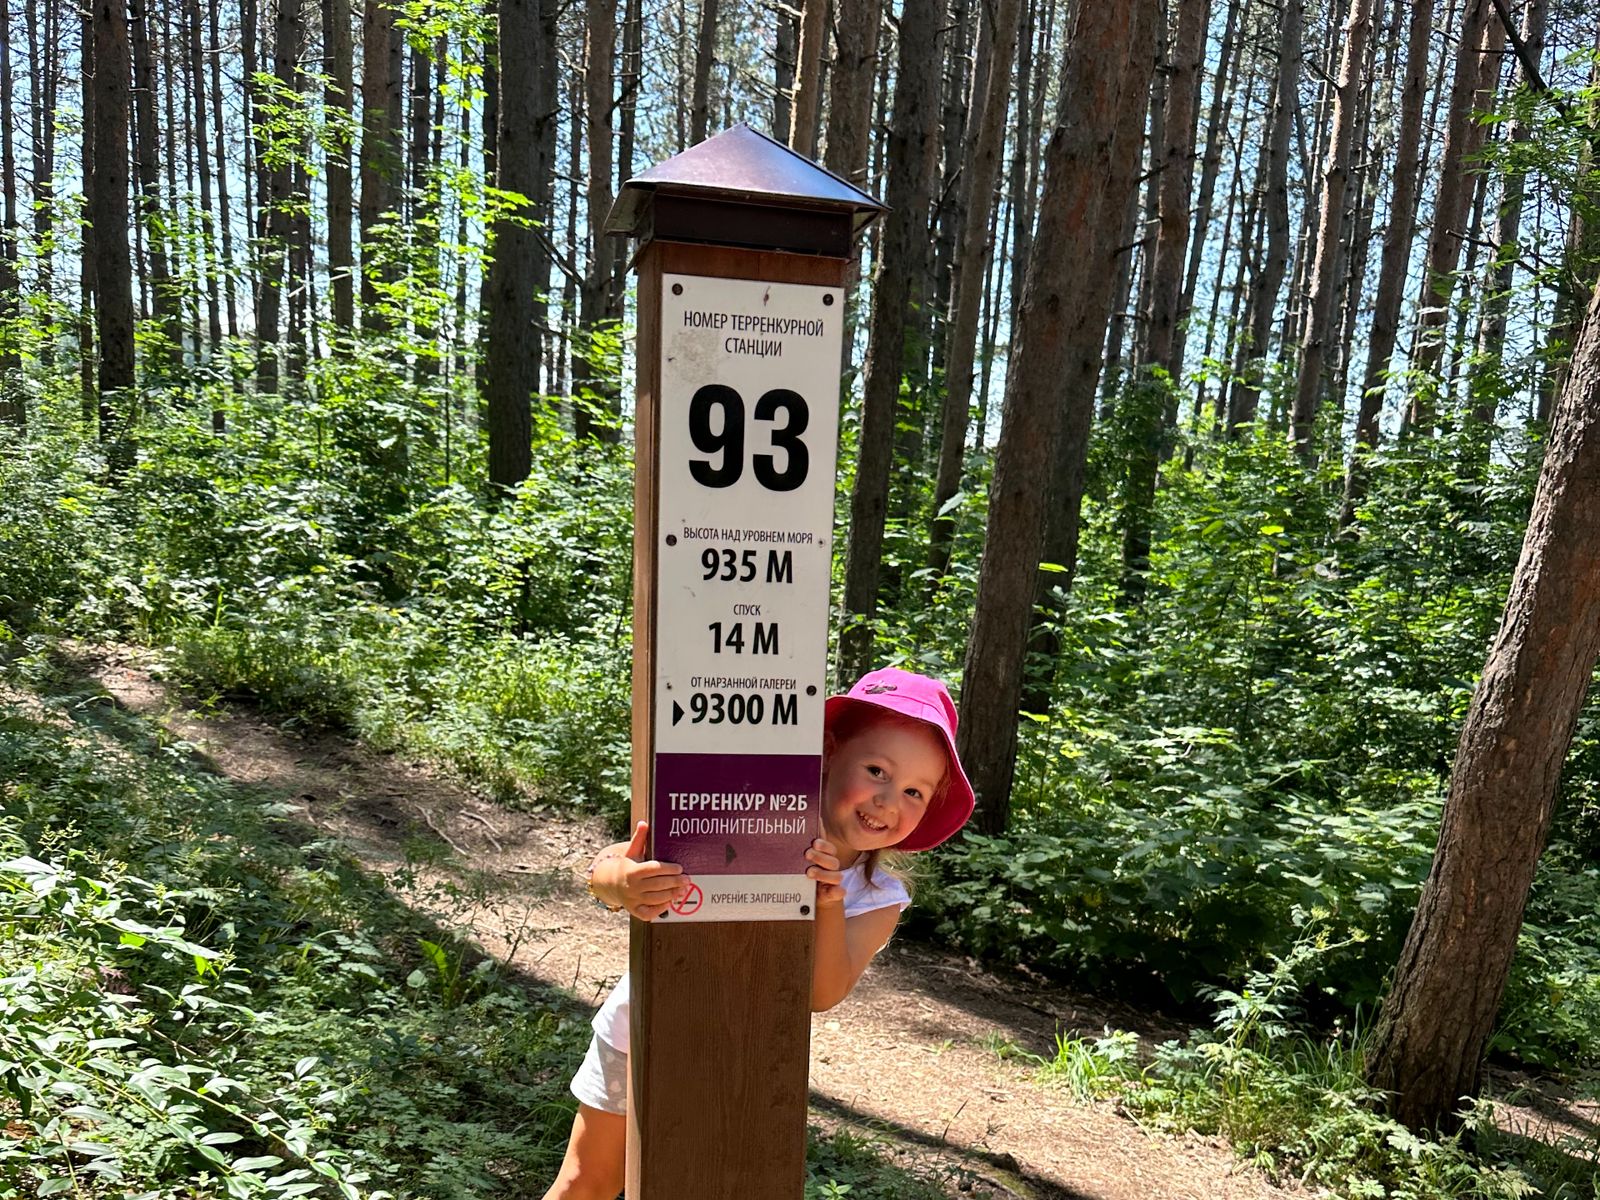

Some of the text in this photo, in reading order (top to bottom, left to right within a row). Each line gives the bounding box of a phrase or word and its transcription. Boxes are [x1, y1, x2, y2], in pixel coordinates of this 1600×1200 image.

[684, 310, 824, 337] НОМЕР ТЕРРЕНКУРНОЙ
[725, 337, 782, 358] СТАНЦИИ
[688, 383, 810, 492] 93
[683, 527, 813, 544] ВЫСОТА НАД УРОВНЕМ МОРЯ
[701, 548, 793, 584] 935 М
[733, 604, 761, 616] СПУСК
[708, 622, 779, 655] 14 М
[691, 677, 796, 690] ОТ НАРЗАННОЙ ГАЛЕРЕИ
[690, 692, 798, 725] 9300 М
[668, 793, 808, 811] ТЕРРЕНКУР №2Б
[669, 816, 806, 837] ДОПОЛНИТЕЛЬНЫЙ
[711, 893, 801, 905] КУРЕНИЕ ЗАПРЕЩЕНО
